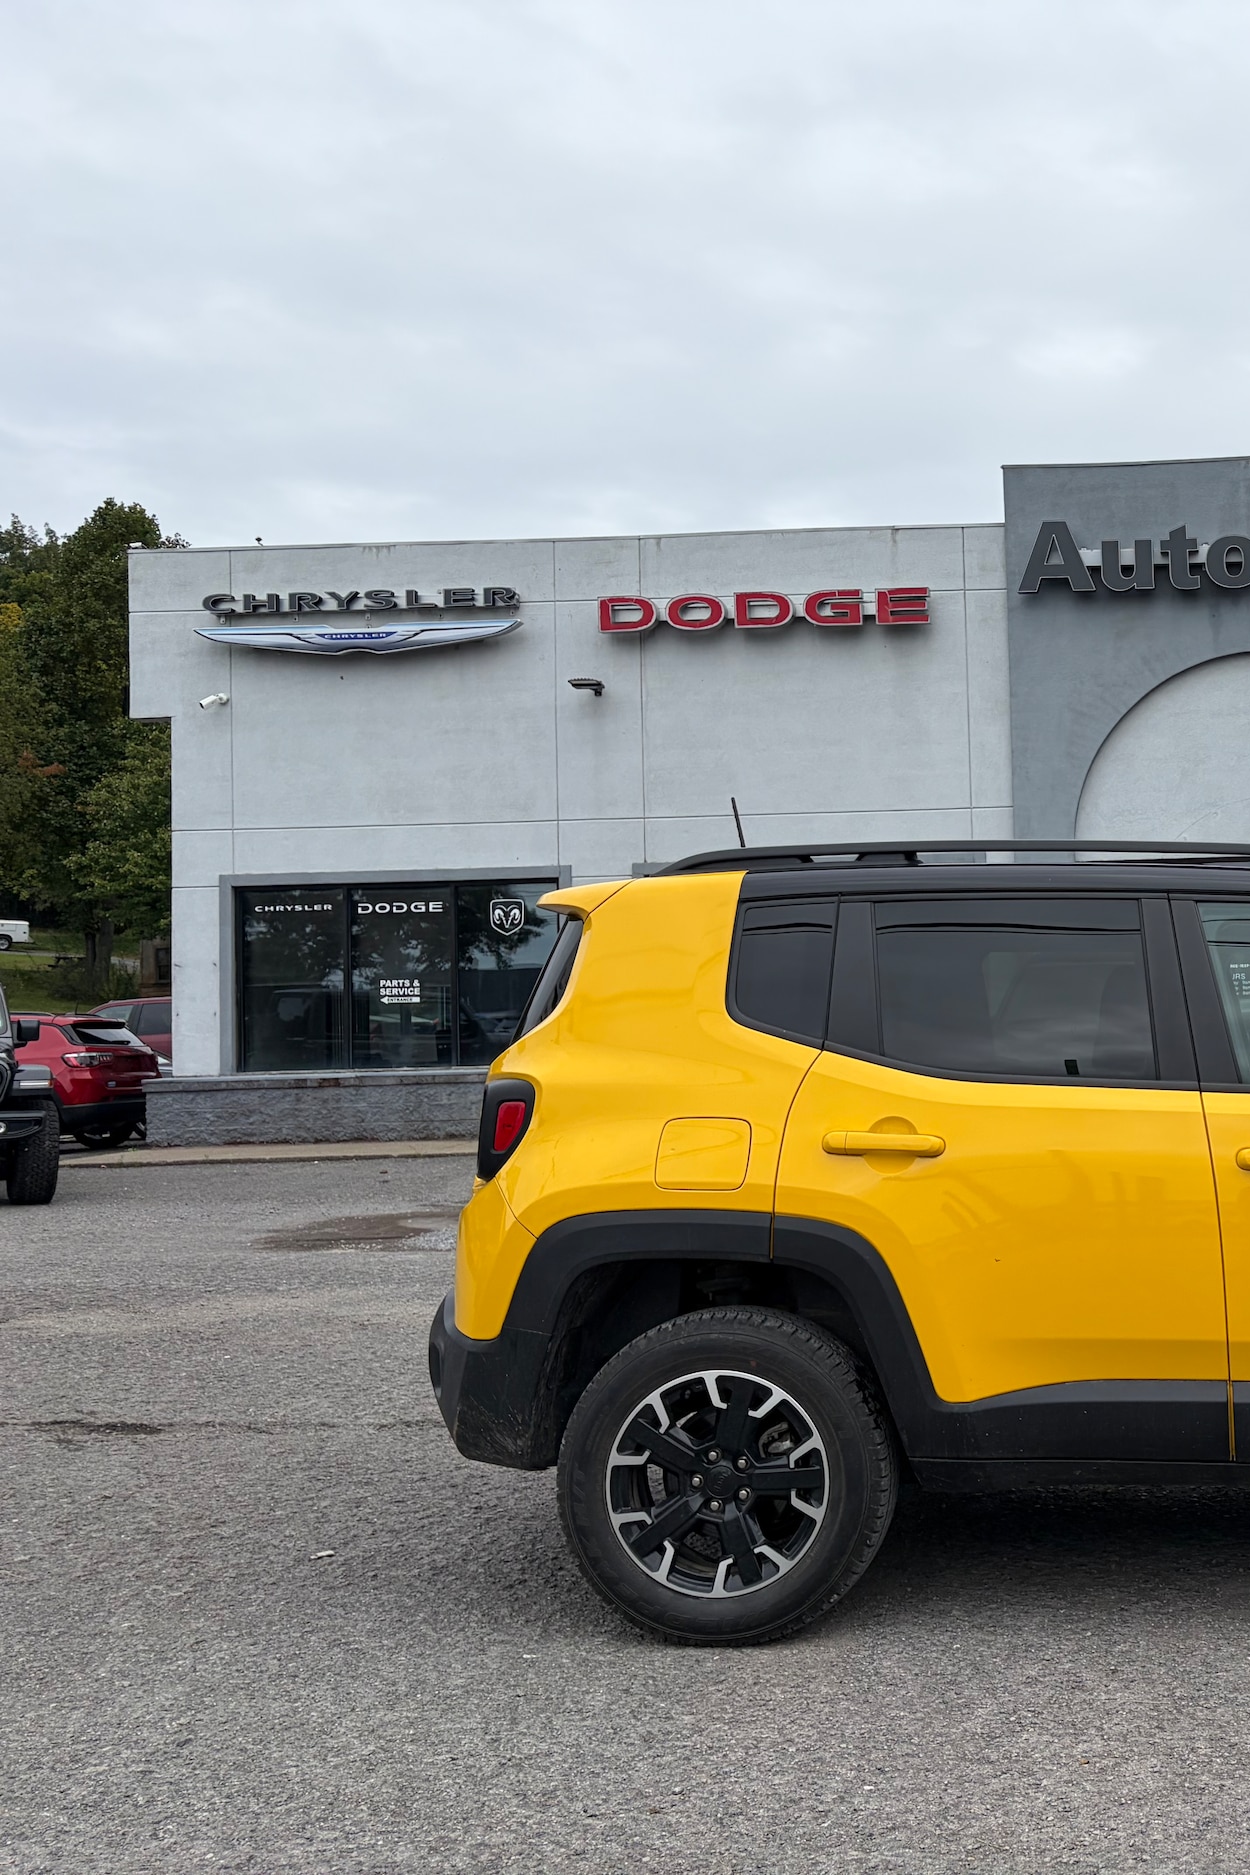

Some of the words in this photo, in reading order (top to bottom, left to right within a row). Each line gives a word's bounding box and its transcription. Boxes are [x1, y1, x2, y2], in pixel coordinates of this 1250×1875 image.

[202, 586, 519, 614] CHRYSLER
[597, 587, 930, 633] DODGE
[254, 903, 333, 913] CHRYSLER
[357, 901, 444, 914] DODGE
[380, 979, 410, 988] PARTS
[413, 979, 420, 987] &
[380, 987, 420, 996] SERVICE
